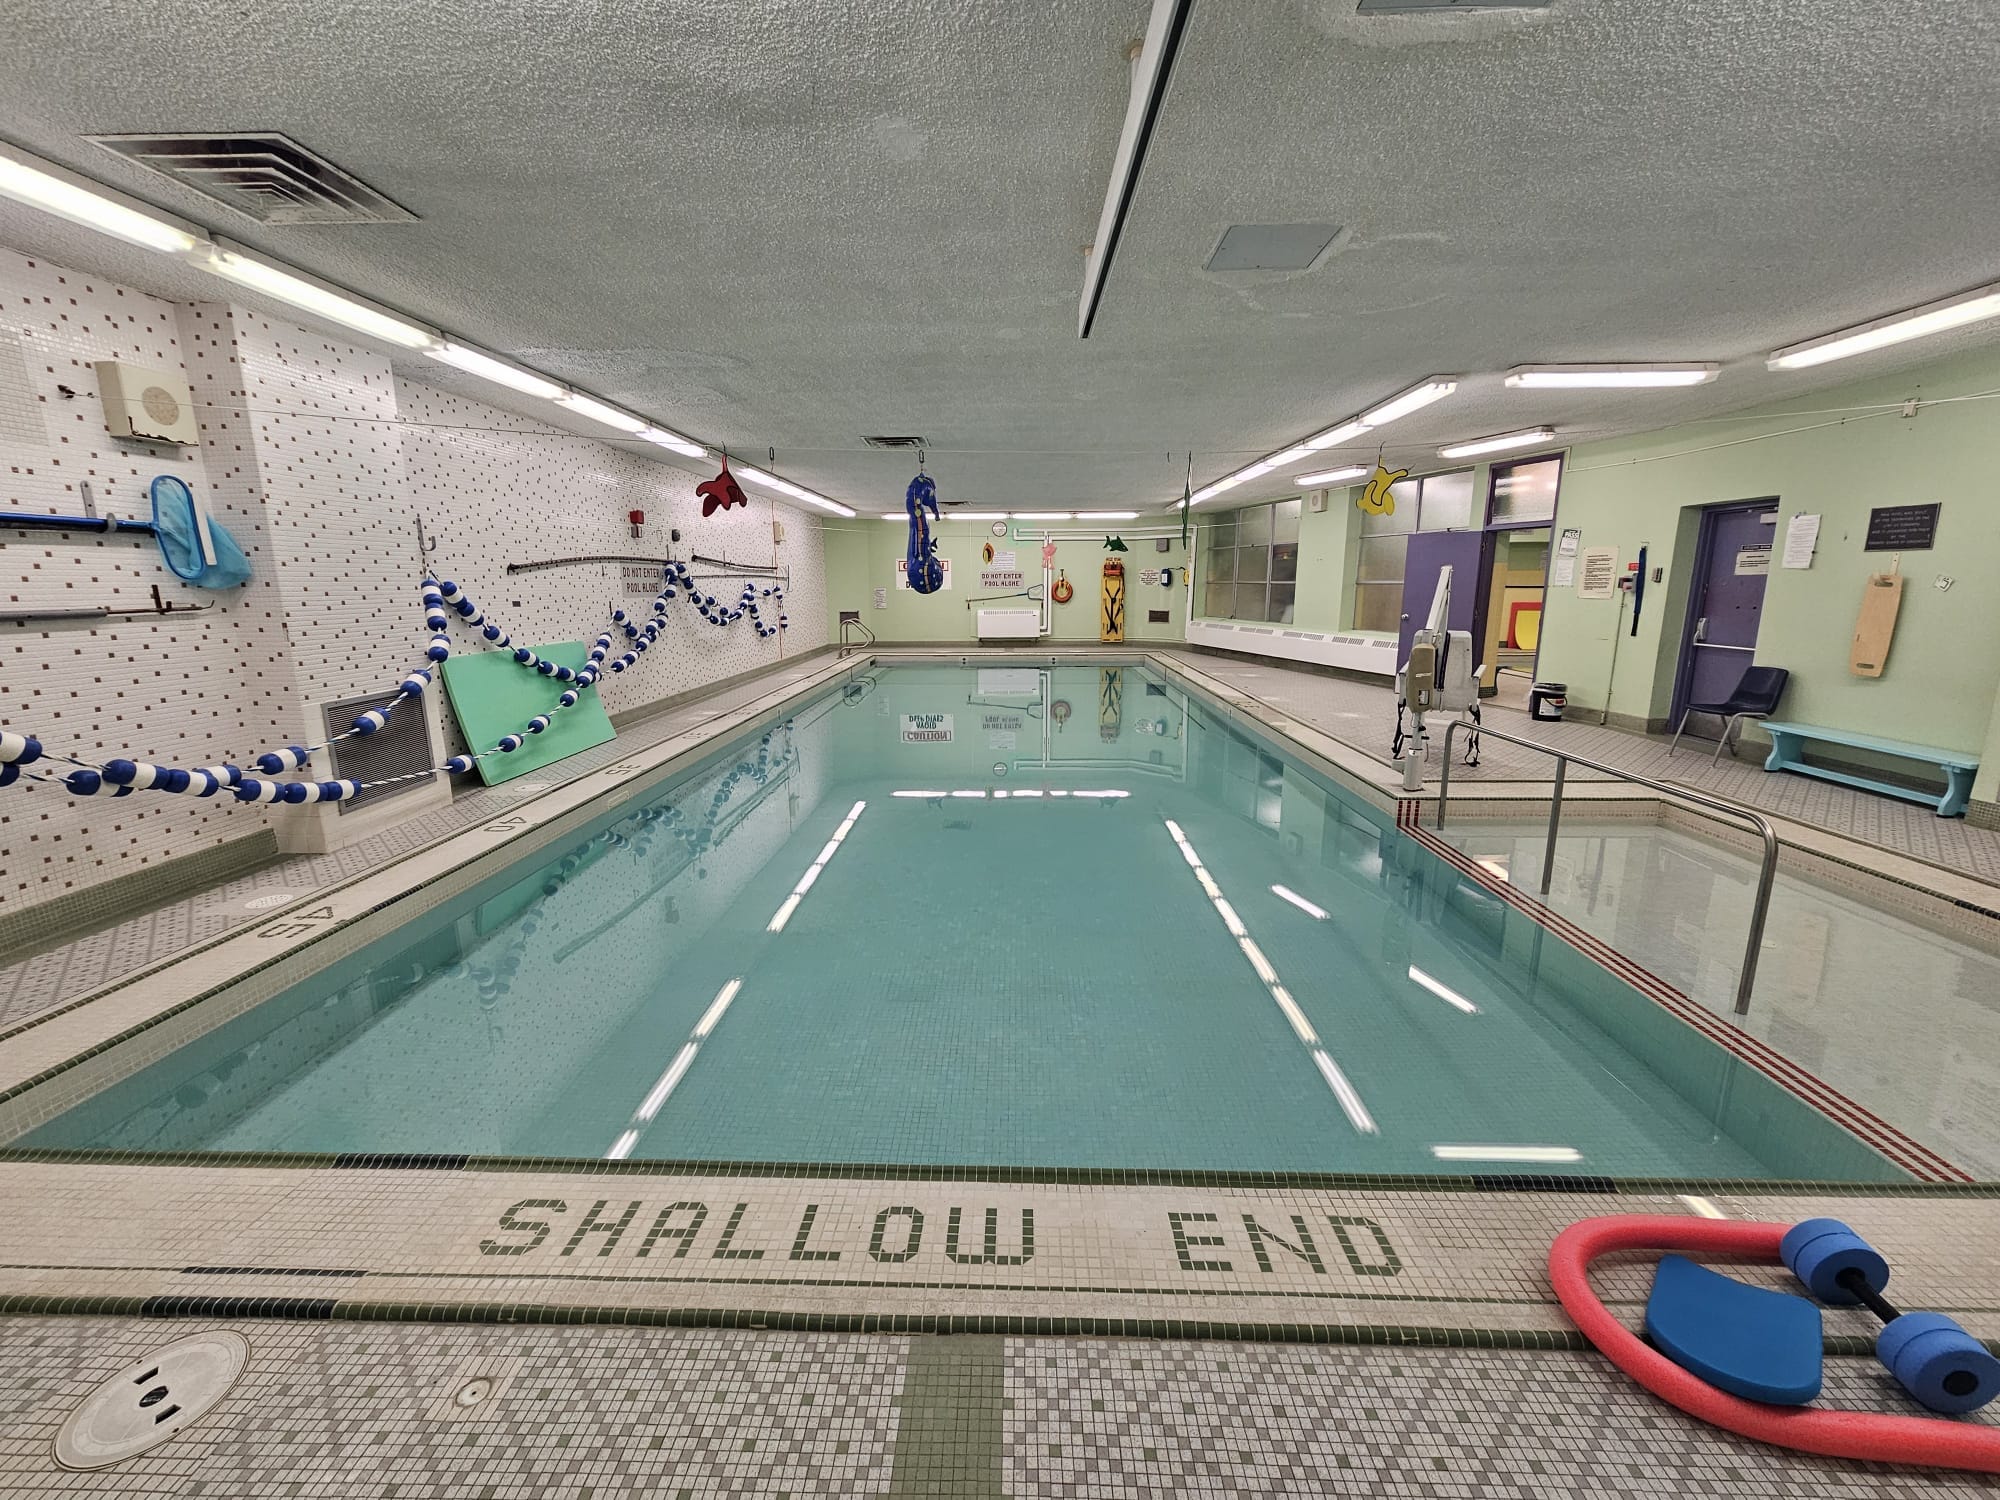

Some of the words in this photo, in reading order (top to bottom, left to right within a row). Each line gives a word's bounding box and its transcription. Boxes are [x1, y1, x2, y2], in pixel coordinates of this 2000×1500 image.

[622, 567, 630, 578] DO
[631, 567, 642, 578] NOT
[643, 567, 660, 578] ENTER
[626, 582, 641, 593] POOL
[642, 582, 659, 593] ALONE
[604, 764, 641, 775] 35
[483, 816, 527, 832] 40
[256, 906, 335, 939] 45
[479, 1199, 1035, 1266] SHALLOW
[1167, 1212, 1403, 1277] END
